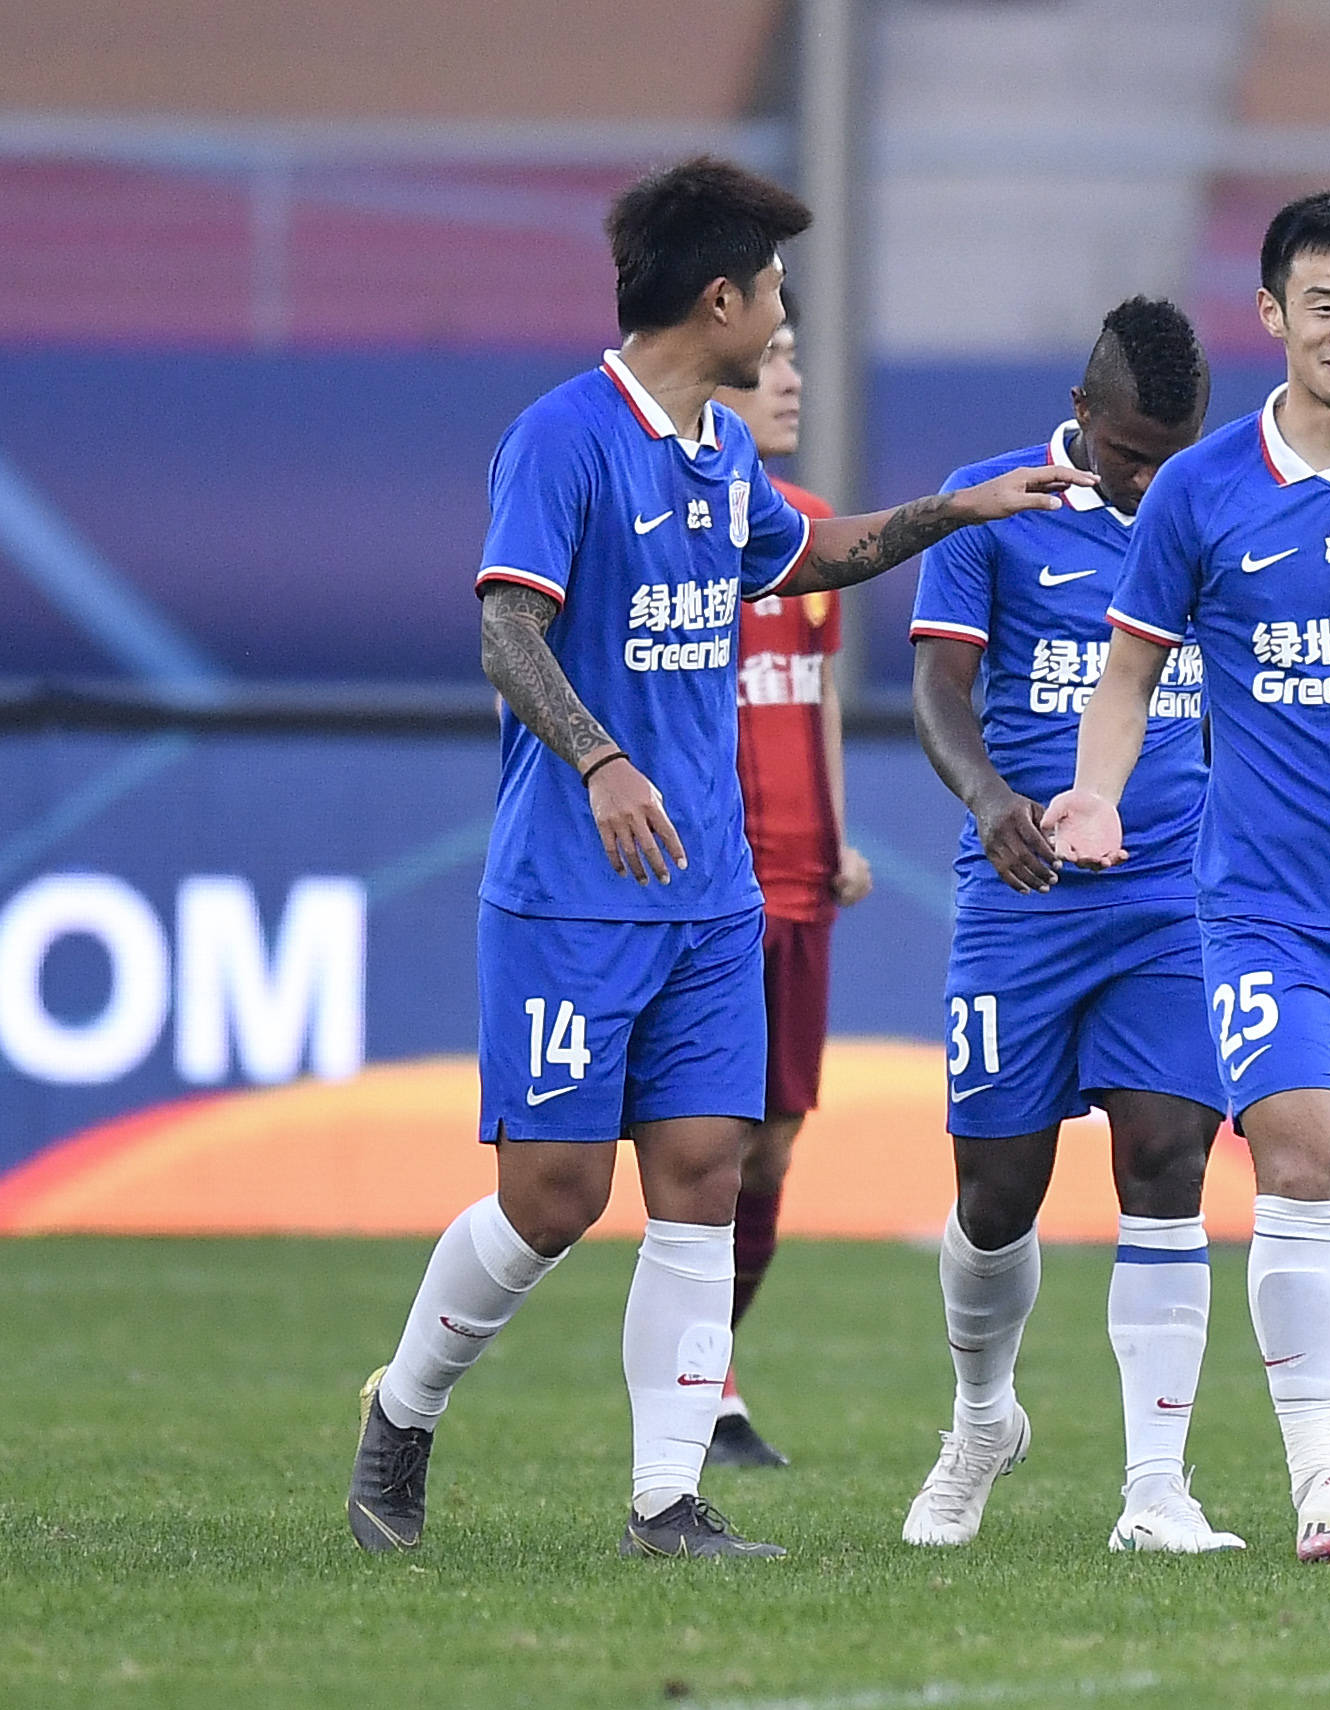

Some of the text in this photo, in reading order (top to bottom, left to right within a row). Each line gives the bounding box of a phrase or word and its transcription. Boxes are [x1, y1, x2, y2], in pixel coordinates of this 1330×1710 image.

[624, 631, 731, 672] Greenla
[1030, 682, 1202, 719] Greland
[0, 870, 367, 1086] OM
[1212, 970, 1280, 1062] 25
[525, 997, 592, 1080] 14
[949, 994, 1000, 1076] 31
